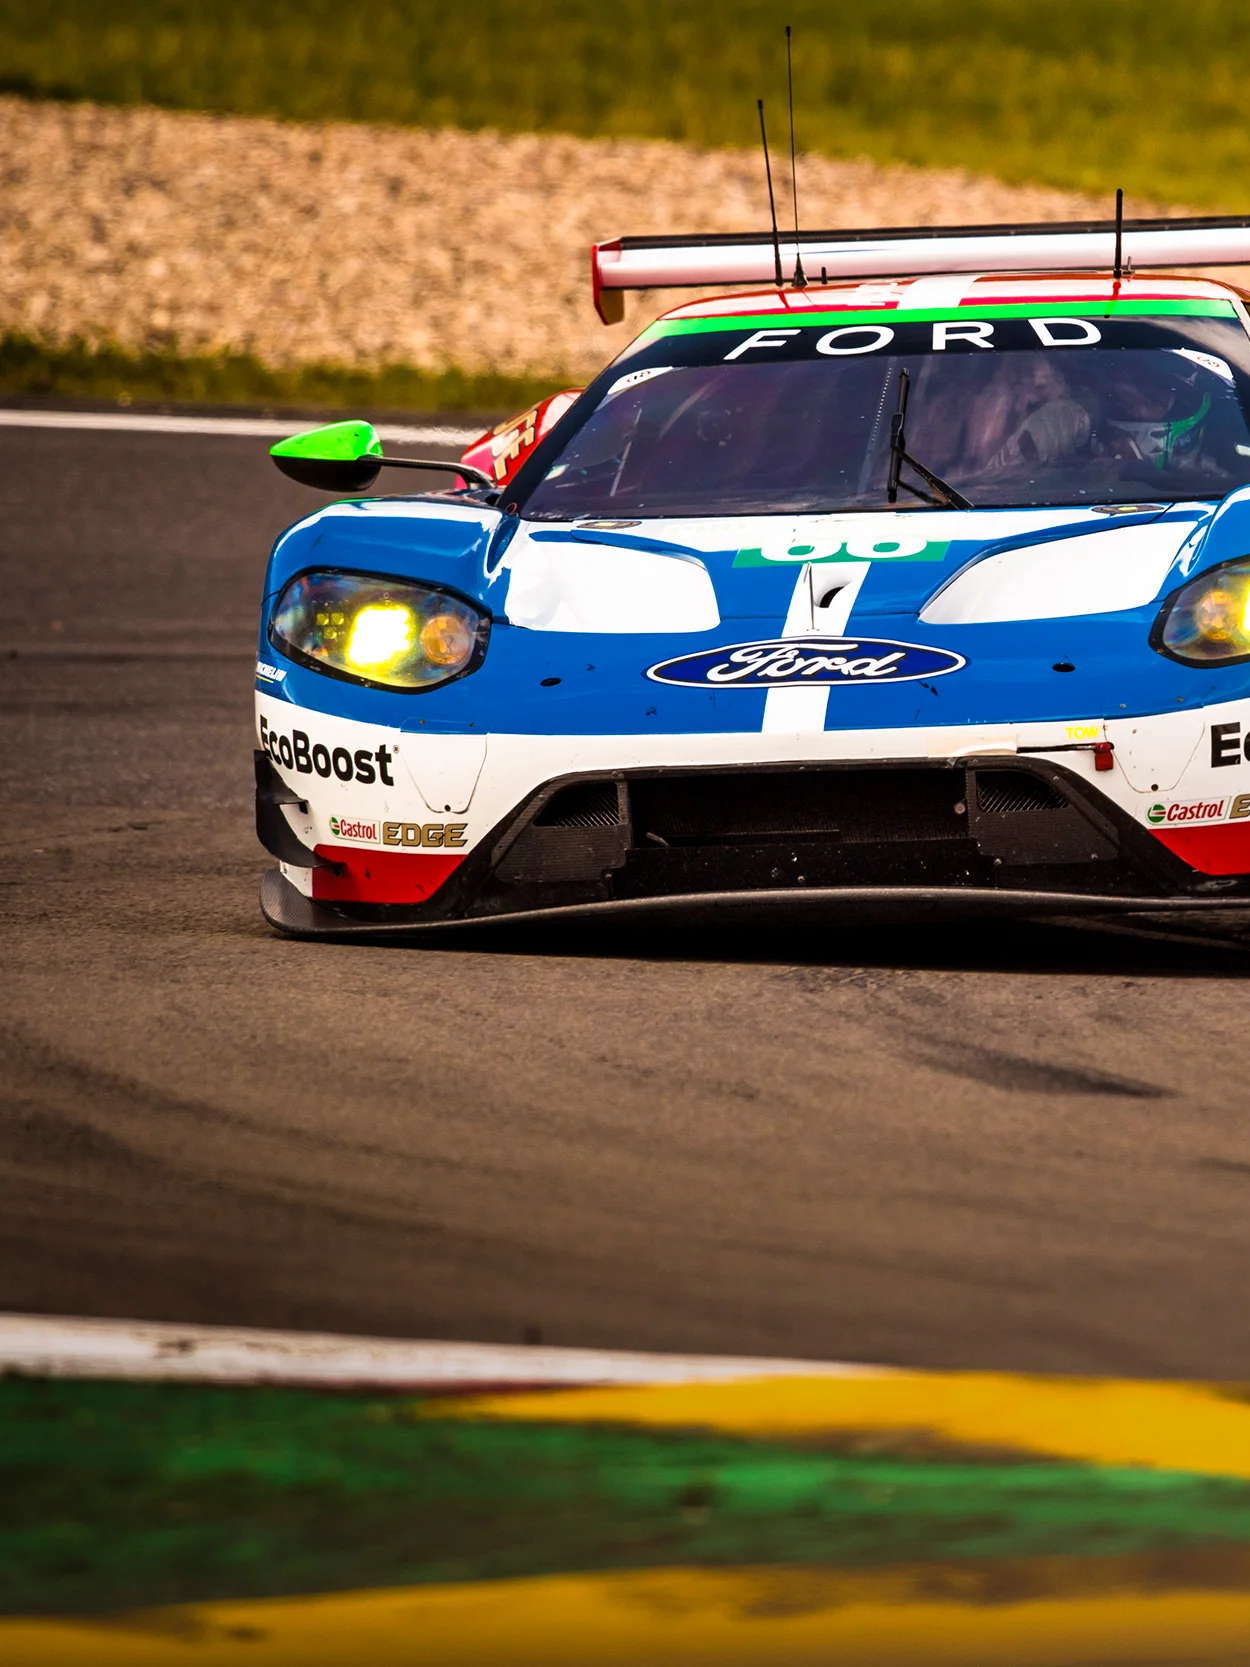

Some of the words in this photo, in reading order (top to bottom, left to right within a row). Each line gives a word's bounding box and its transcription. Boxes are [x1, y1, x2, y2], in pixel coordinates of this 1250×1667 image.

[723, 318, 1102, 361] FORD
[256, 661, 287, 681] ICHELIN
[707, 643, 905, 682] Ford
[1065, 725, 1099, 740] TOW
[260, 713, 395, 787] EcoBoost
[1167, 800, 1224, 822] Castrol
[340, 819, 378, 840] Castrol
[382, 821, 469, 848] EDGE
